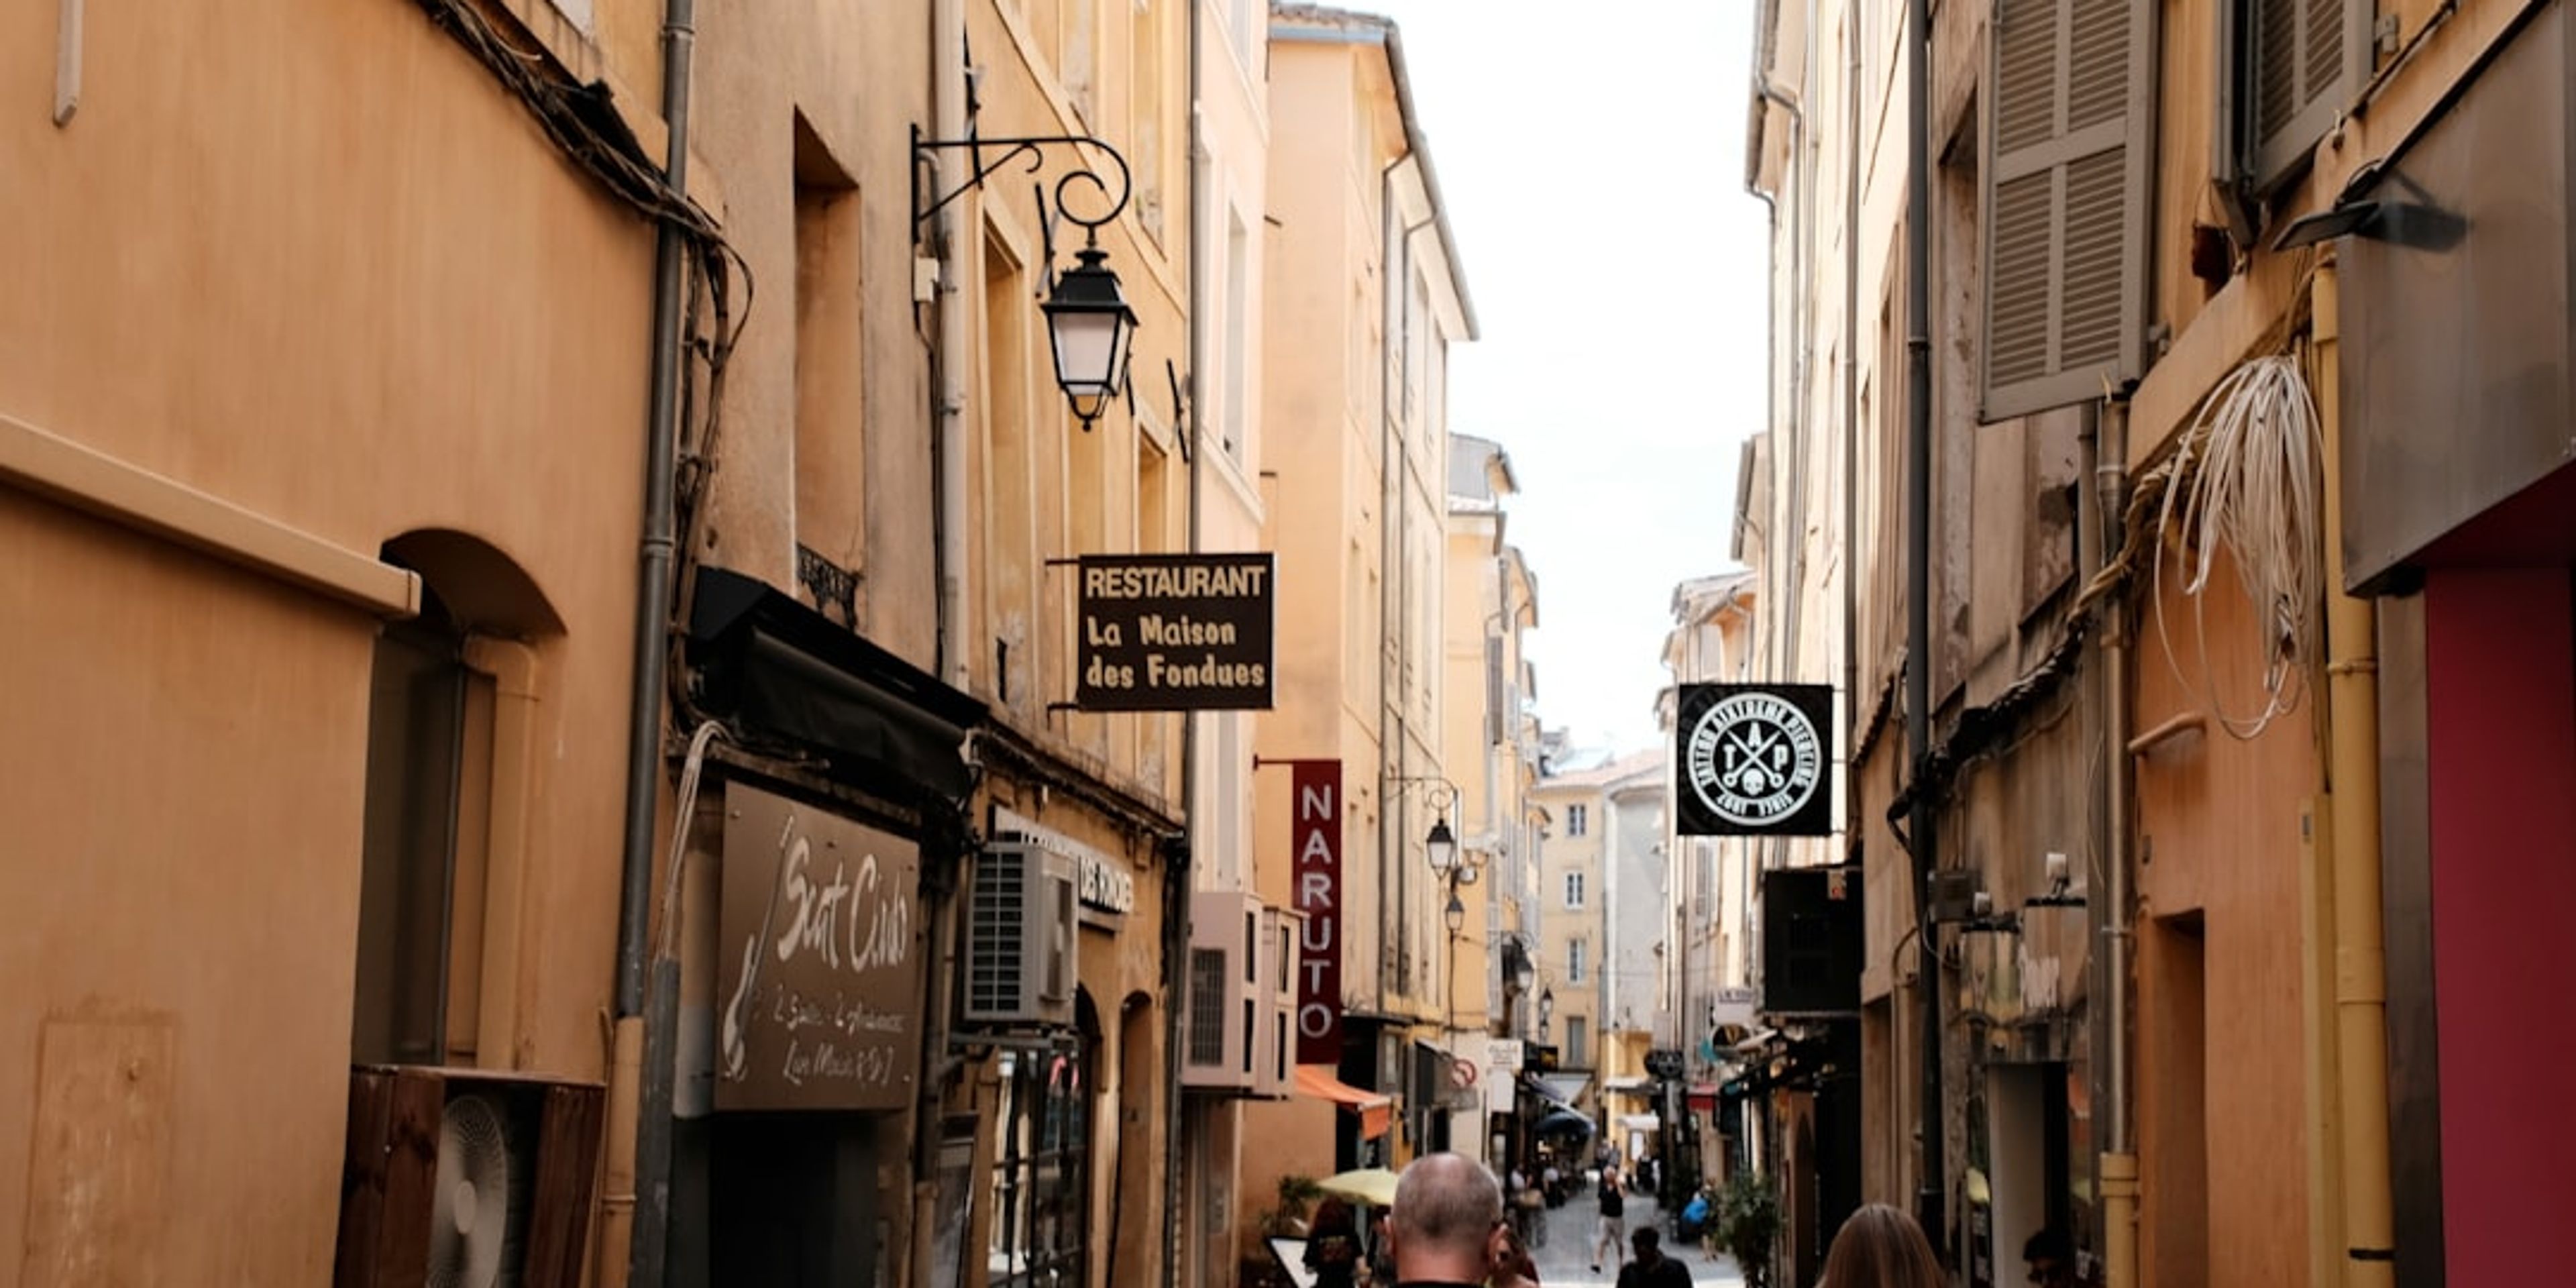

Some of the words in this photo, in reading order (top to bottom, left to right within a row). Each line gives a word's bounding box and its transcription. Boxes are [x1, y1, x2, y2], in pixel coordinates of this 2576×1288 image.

[1086, 566, 1267, 598] RESTAURANT
[1087, 615, 1122, 647] La
[1140, 614, 1236, 646] Maison
[1086, 655, 1134, 688] des
[1146, 653, 1266, 688] Fondues
[777, 837, 850, 971] Scat
[1299, 784, 1332, 1038] NARUTO
